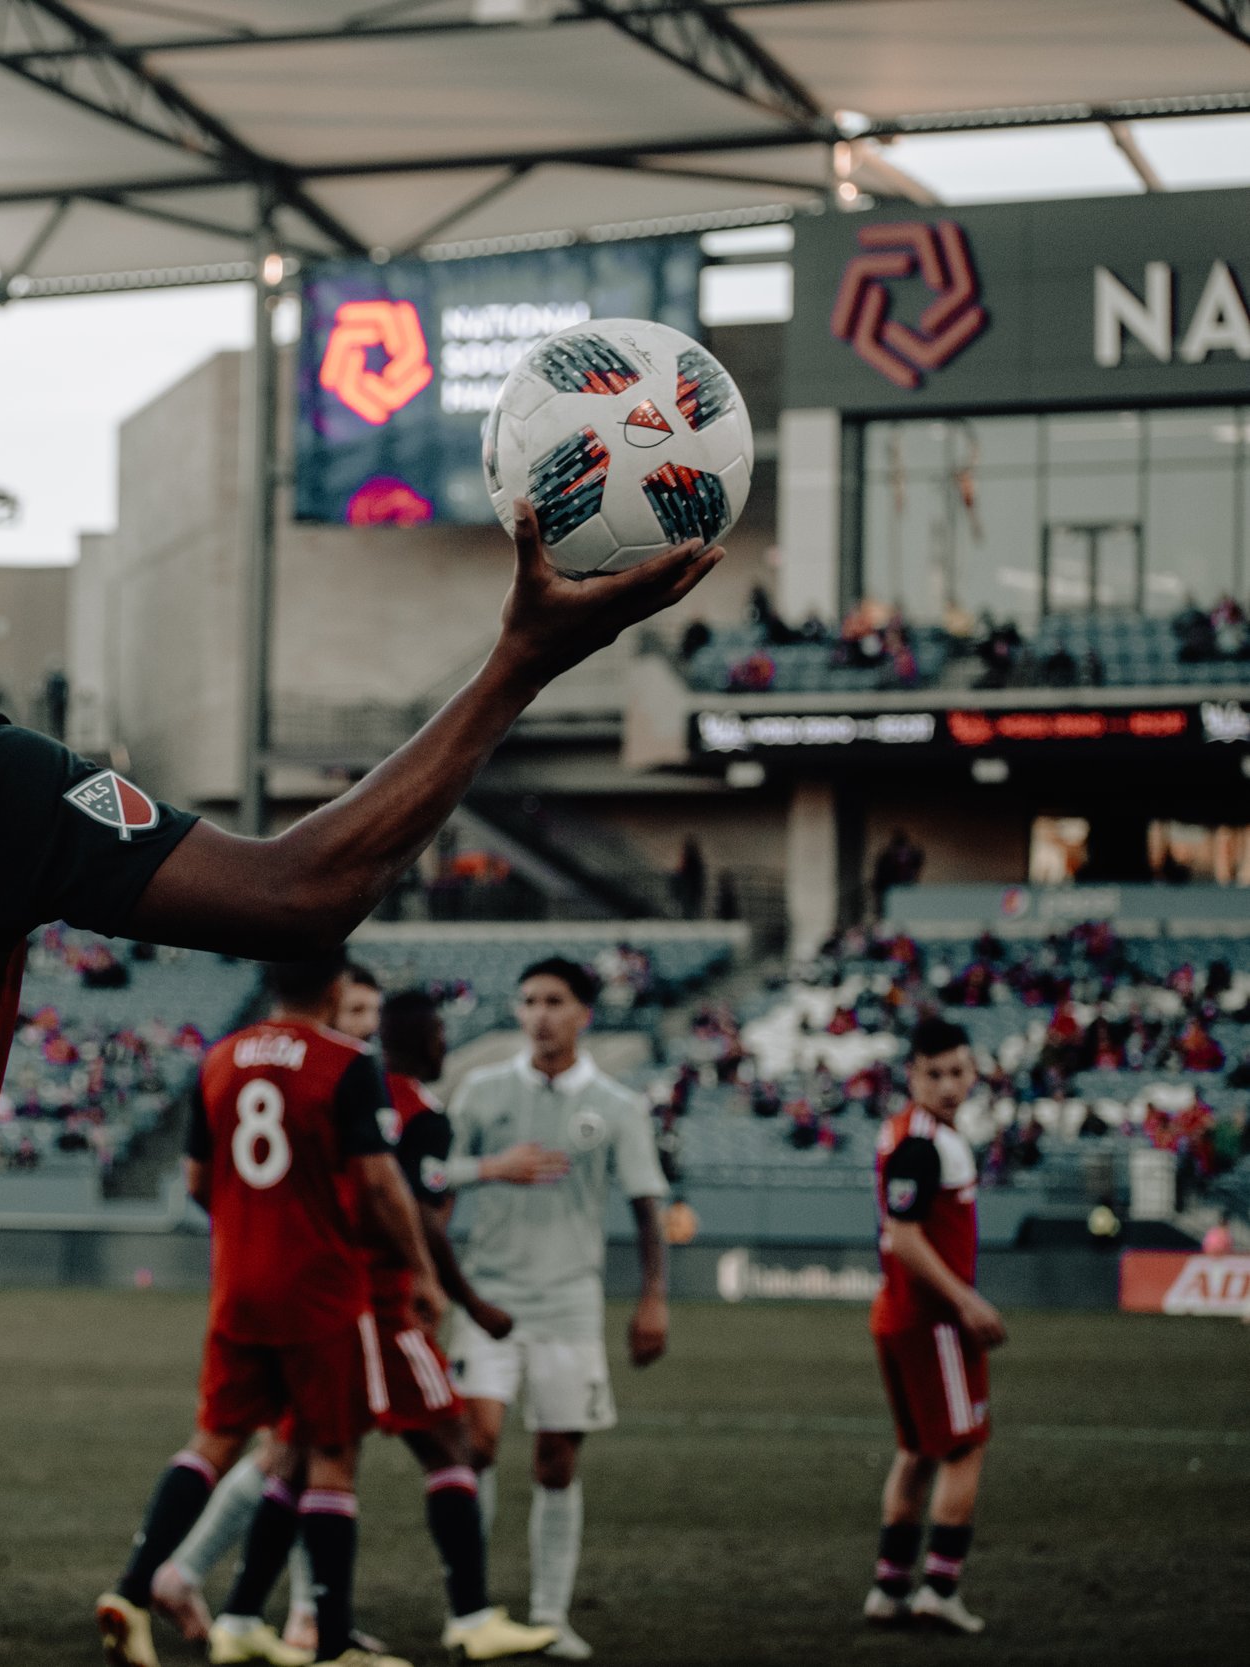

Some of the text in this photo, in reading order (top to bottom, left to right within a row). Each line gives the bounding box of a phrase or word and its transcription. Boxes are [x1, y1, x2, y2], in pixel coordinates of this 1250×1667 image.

[1094, 259, 1250, 368] NA
[77, 782, 110, 806] MLS
[232, 1078, 292, 1190] 8
